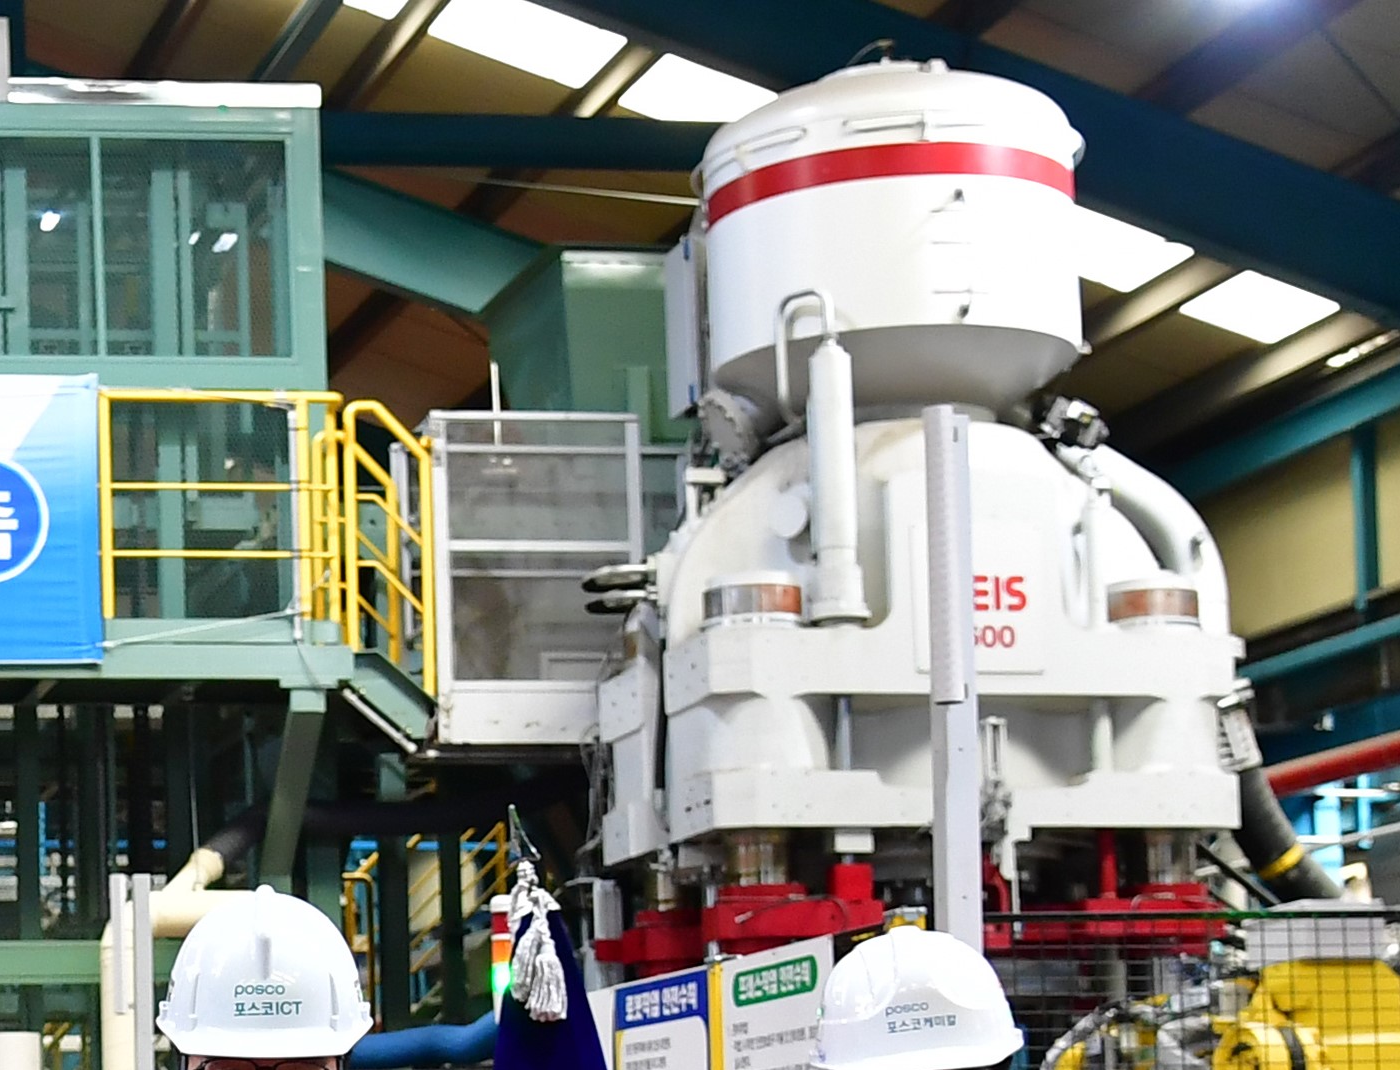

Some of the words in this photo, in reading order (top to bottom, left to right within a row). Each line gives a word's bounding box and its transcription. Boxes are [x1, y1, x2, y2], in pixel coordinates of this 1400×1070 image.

[973, 575, 1027, 611] EIS
[234, 984, 286, 998] posco
[233, 1000, 303, 1017] 포스코ICT
[885, 1002, 929, 1017] posco
[886, 1014, 957, 1034] 포스코케미칼
